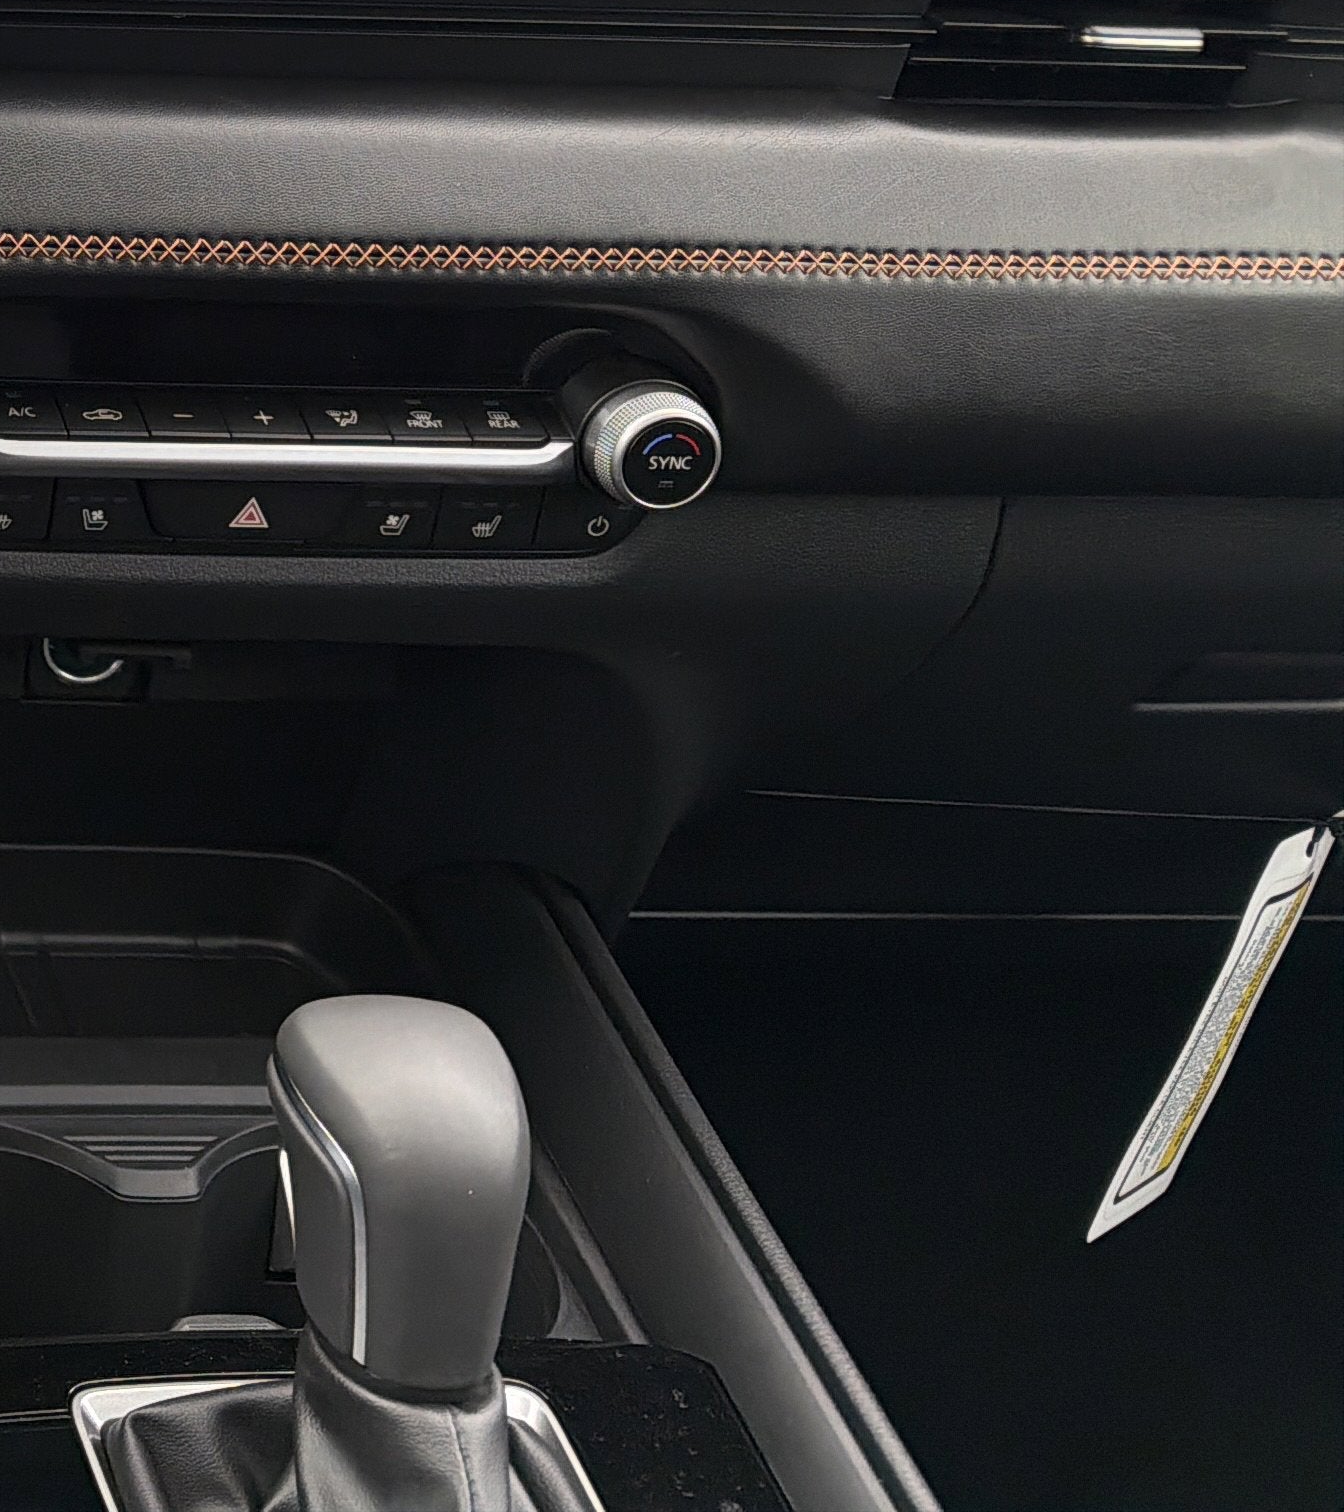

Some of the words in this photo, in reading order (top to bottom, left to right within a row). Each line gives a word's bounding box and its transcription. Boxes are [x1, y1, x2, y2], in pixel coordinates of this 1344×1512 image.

[8, 405, 38, 419] A/C
[406, 418, 444, 430] FRONT
[487, 418, 521, 430] REAR
[648, 454, 694, 472] SYNC
